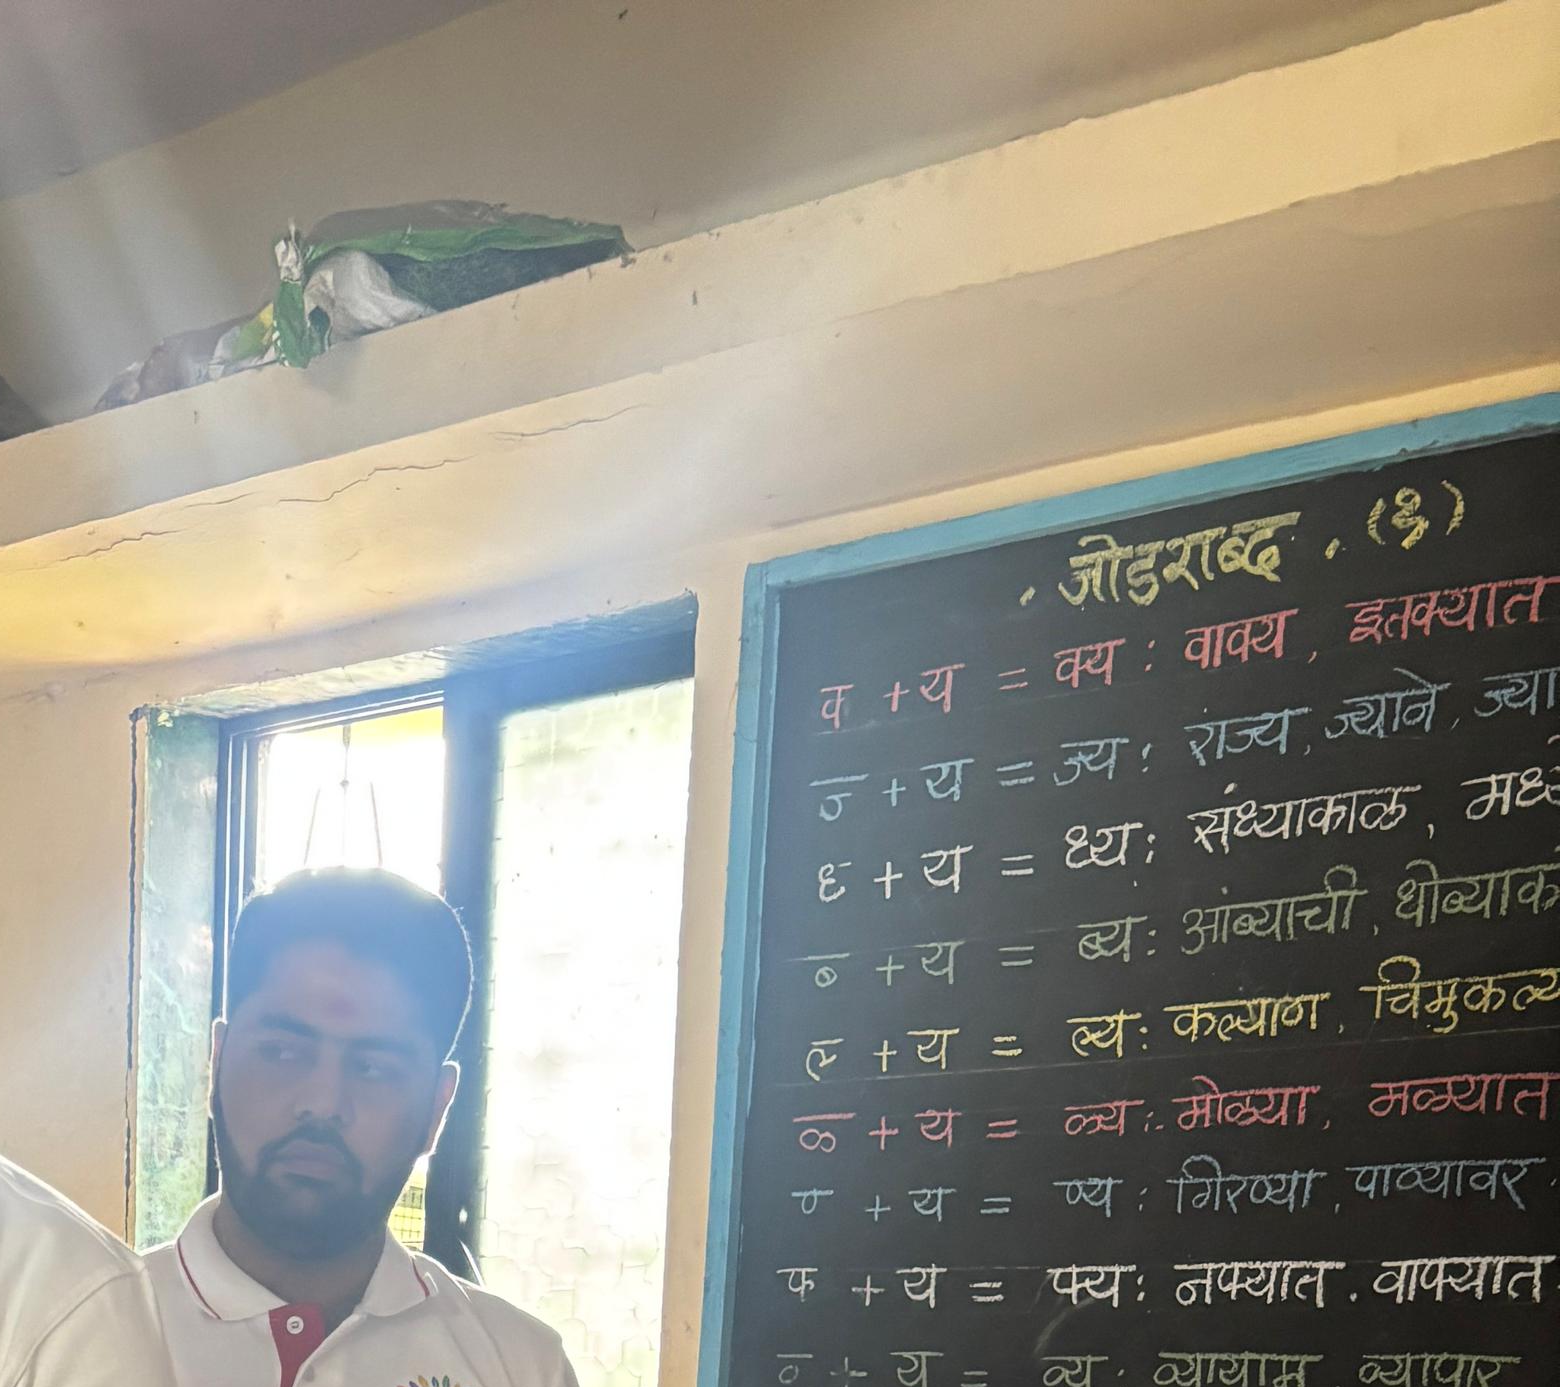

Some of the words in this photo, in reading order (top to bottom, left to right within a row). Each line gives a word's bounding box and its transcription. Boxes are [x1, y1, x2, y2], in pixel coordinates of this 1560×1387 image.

[920, 663, 966, 713] य
[920, 758, 975, 801] य
[920, 844, 974, 893] य
[915, 941, 966, 985] य
[1395, 858, 1560, 928] धोब्याक
[907, 1028, 960, 1070] य
[914, 1108, 963, 1148] य
[908, 1186, 957, 1222] य
[895, 1264, 948, 1309] य
